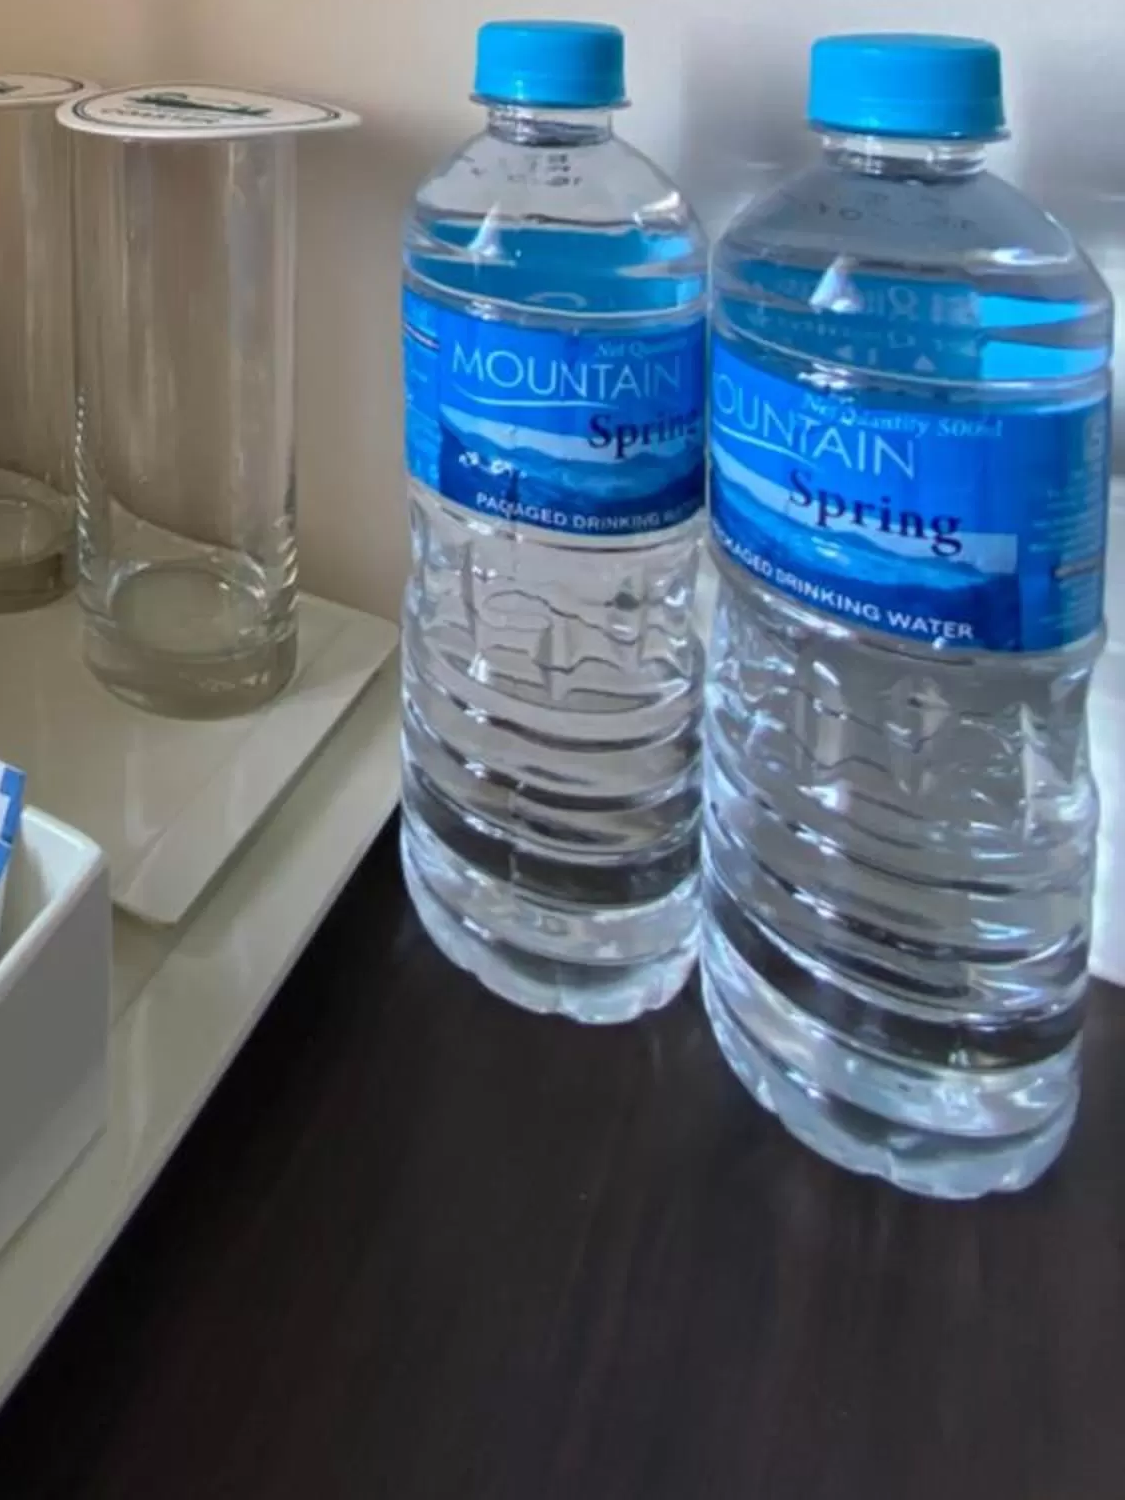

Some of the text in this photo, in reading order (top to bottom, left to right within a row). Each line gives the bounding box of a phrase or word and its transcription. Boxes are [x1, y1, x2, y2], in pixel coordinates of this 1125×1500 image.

[451, 340, 681, 401] MOUNTAIN
[712, 372, 915, 480] OUNTAIN
[789, 467, 964, 558] Spring
[776, 565, 881, 621] DRINKING
[886, 608, 973, 640] WATER
